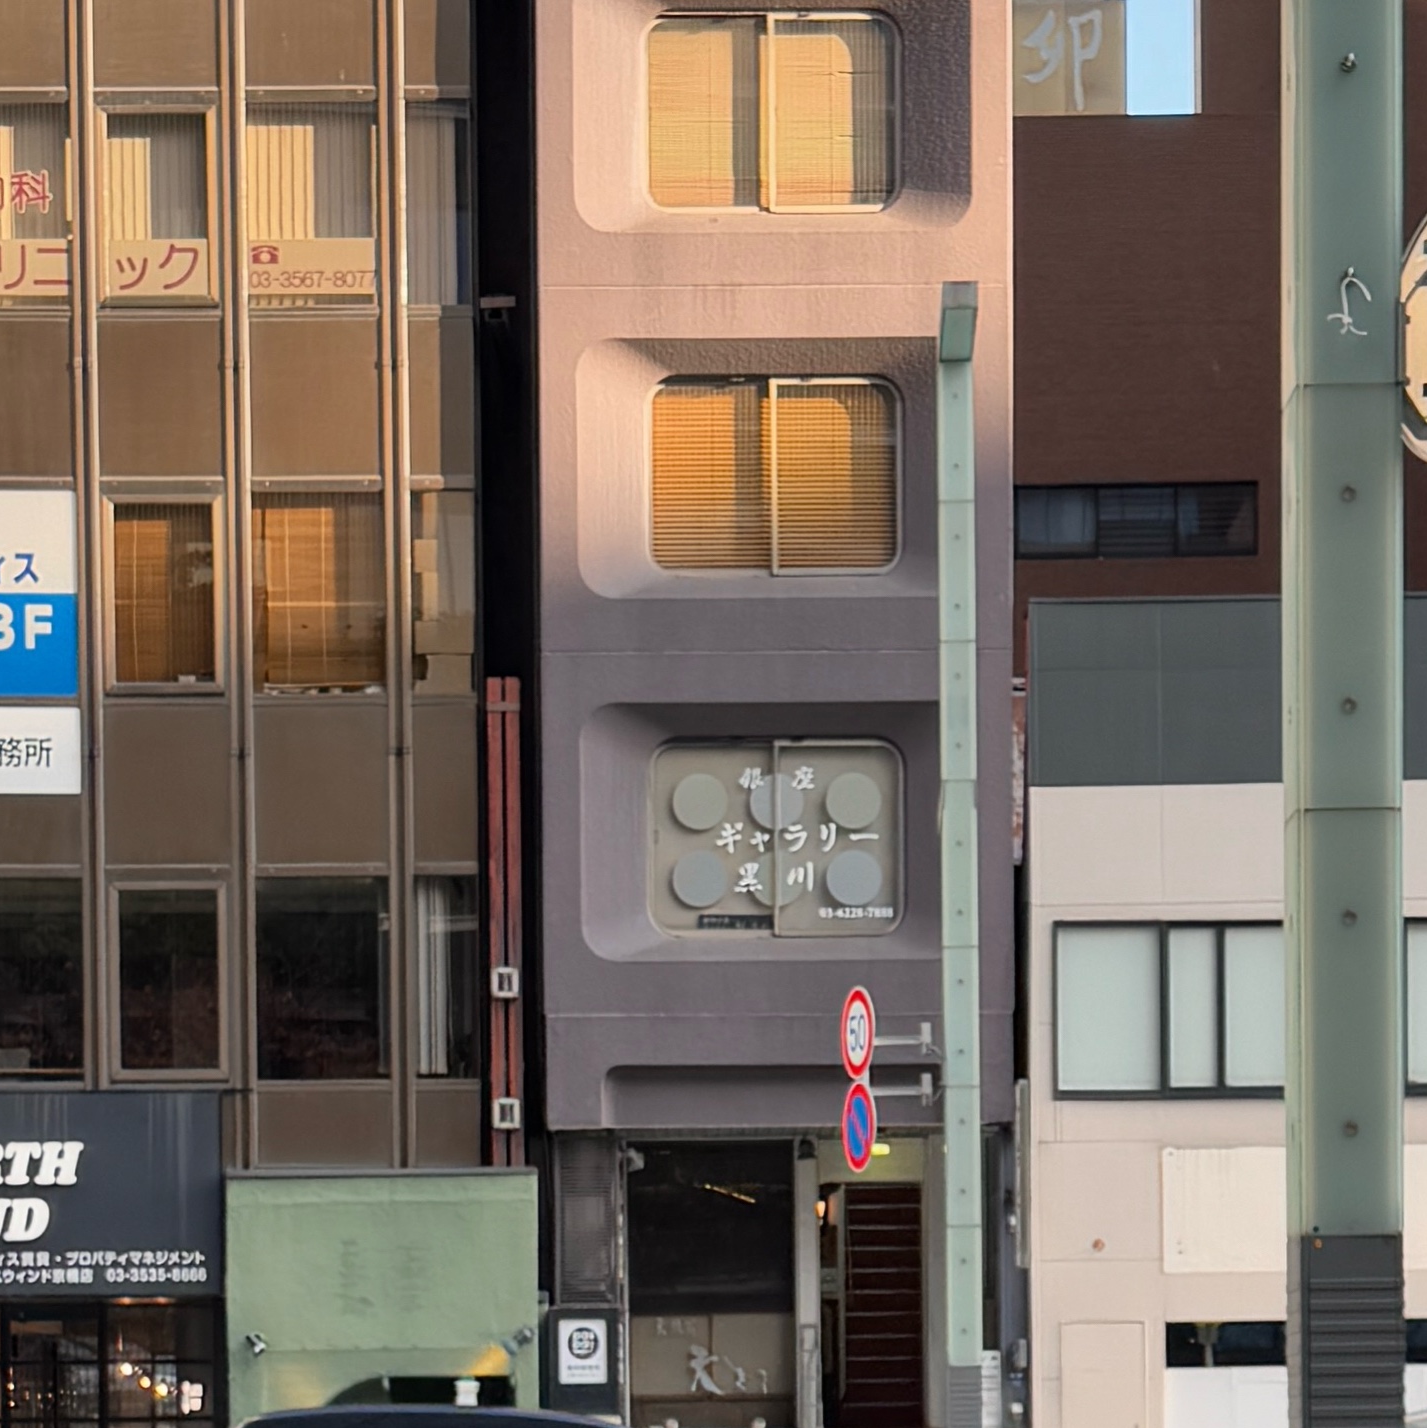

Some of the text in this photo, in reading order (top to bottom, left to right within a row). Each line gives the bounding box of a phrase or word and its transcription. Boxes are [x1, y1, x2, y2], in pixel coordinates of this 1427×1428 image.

[738, 766, 815, 789] 銀座
[715, 822, 880, 854] ギャラリー
[734, 861, 815, 892] 黒川
[850, 1014, 865, 1051] 50
